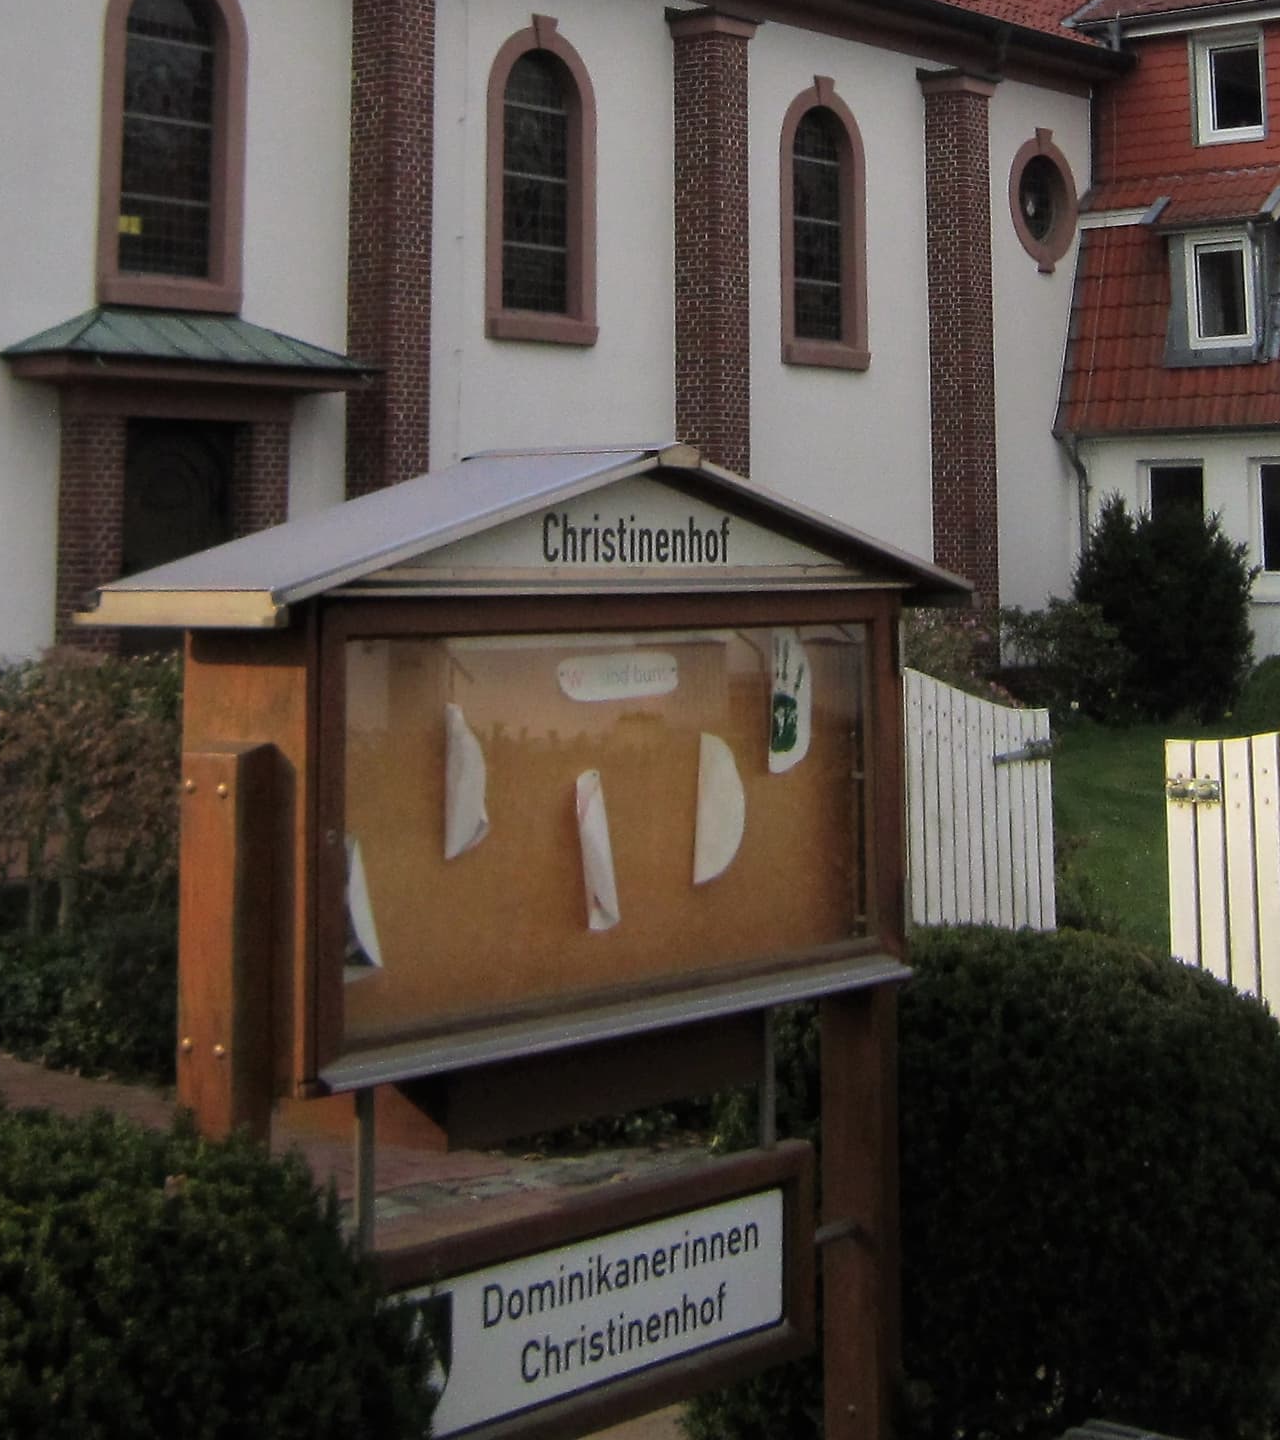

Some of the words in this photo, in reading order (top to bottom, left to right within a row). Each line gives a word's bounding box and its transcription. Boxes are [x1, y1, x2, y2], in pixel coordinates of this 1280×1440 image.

[543, 513, 730, 563] Christinenhof
[483, 1221, 759, 1329] Dominikanerinnen
[521, 1281, 726, 1383] Christinenhof
